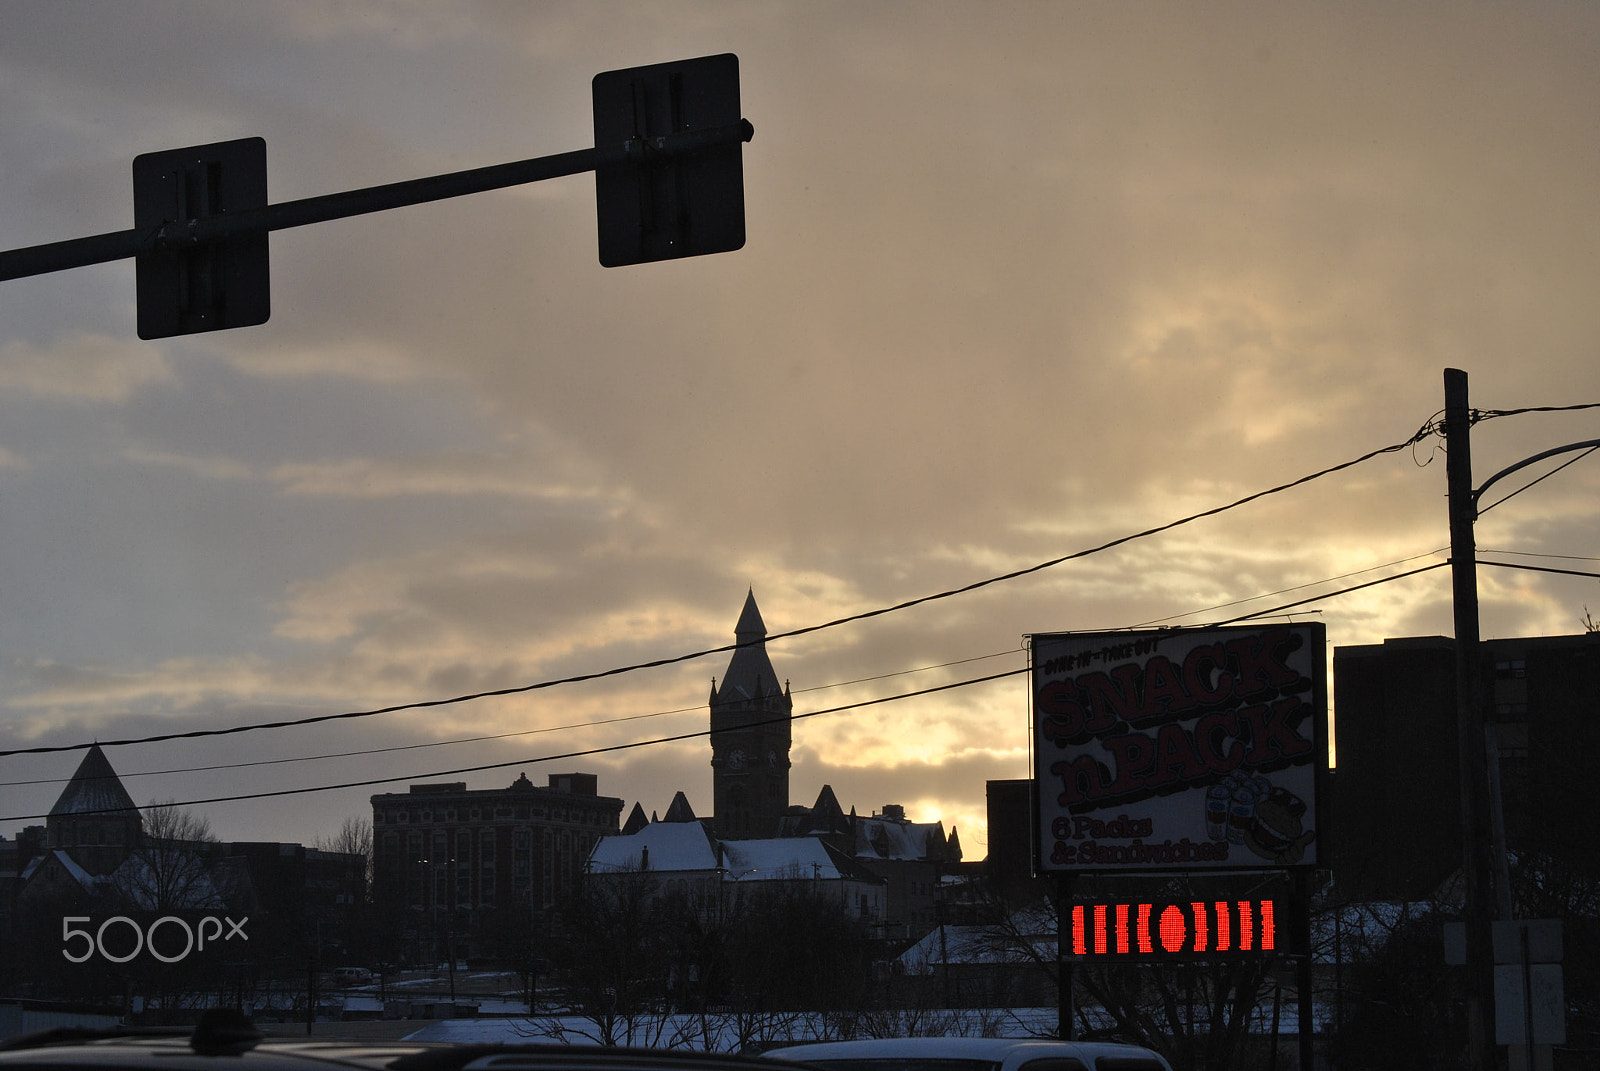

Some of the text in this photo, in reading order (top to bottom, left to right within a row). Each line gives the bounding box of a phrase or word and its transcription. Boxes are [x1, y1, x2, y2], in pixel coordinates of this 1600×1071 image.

[1135, 636, 1160, 656] OUT
[1038, 628, 1300, 741] SNACK
[1051, 814, 1153, 840] 6 Packs
[1077, 838, 1229, 865] Sandwiches
